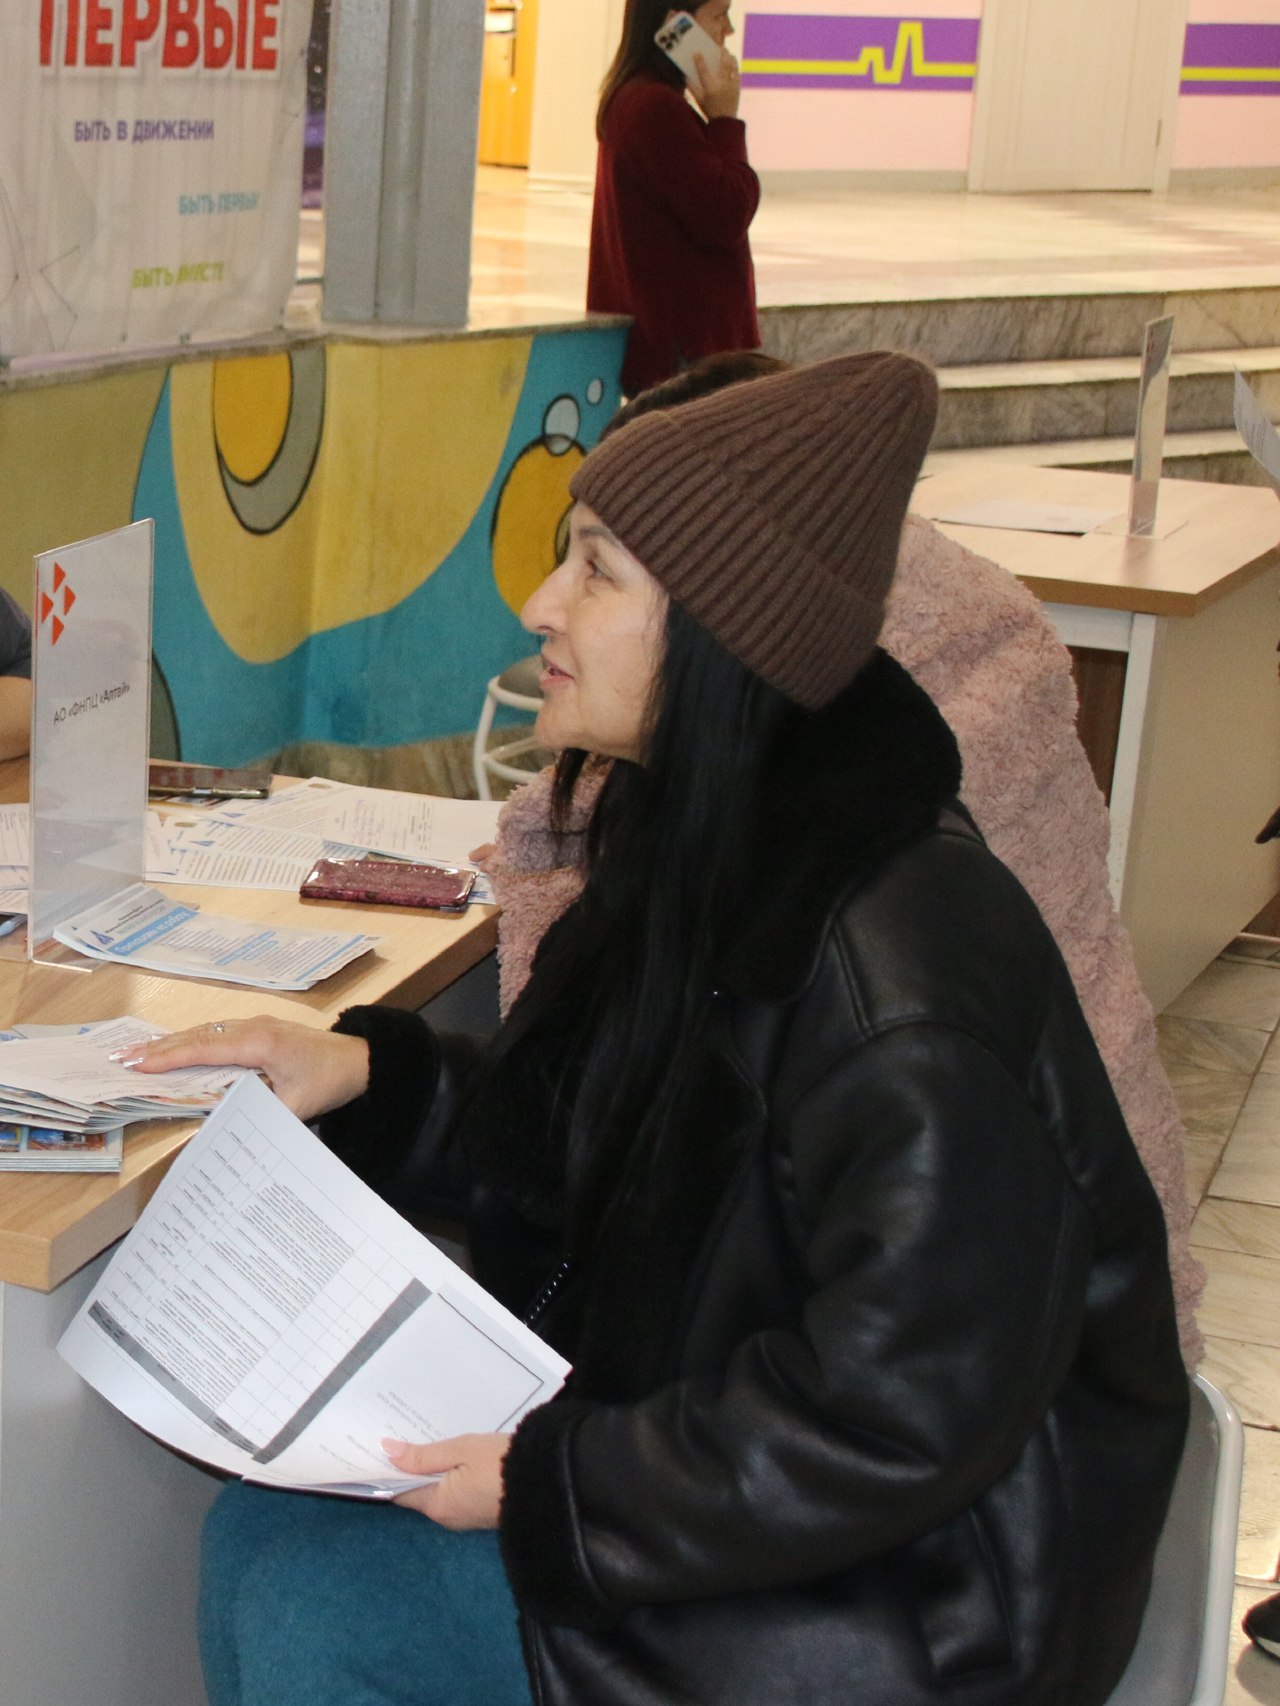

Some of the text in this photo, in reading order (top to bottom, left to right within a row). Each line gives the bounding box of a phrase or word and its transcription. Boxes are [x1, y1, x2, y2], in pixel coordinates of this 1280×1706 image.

[39, 0, 278, 70] ПЕРВЫЕ
[74, 119, 215, 144] БЫТЬ В ДВИЖЕНИИ
[53, 707, 67, 726] АО
